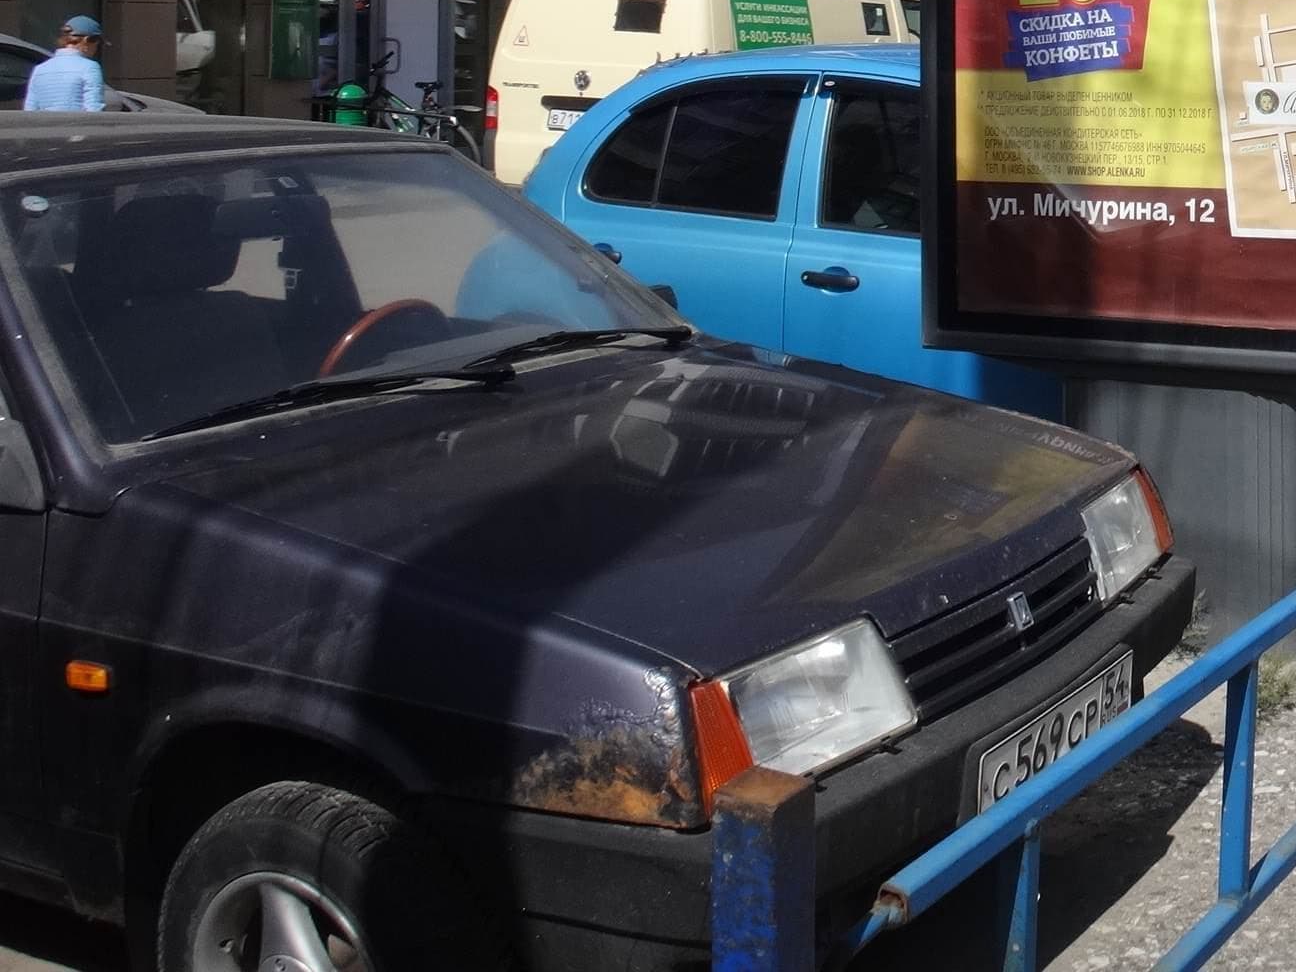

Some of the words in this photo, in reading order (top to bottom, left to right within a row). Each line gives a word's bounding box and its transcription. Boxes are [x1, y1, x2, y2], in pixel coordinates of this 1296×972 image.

[1020, 12, 1085, 33] СКИДКА
[1087, 9, 1113, 24] НА
[1022, 33, 1057, 47] ВАШИ
[1058, 26, 1116, 42] ЛЮБИМЫЕ
[1024, 40, 1119, 67] КОНФЕТЫ
[1091, 92, 1133, 103] ЦЕННИКОМ
[1156, 108, 1166, 118] ПО
[987, 196, 1025, 221] ул.
[1033, 192, 1176, 226] Мичурина,
[1185, 197, 1216, 223] 12
